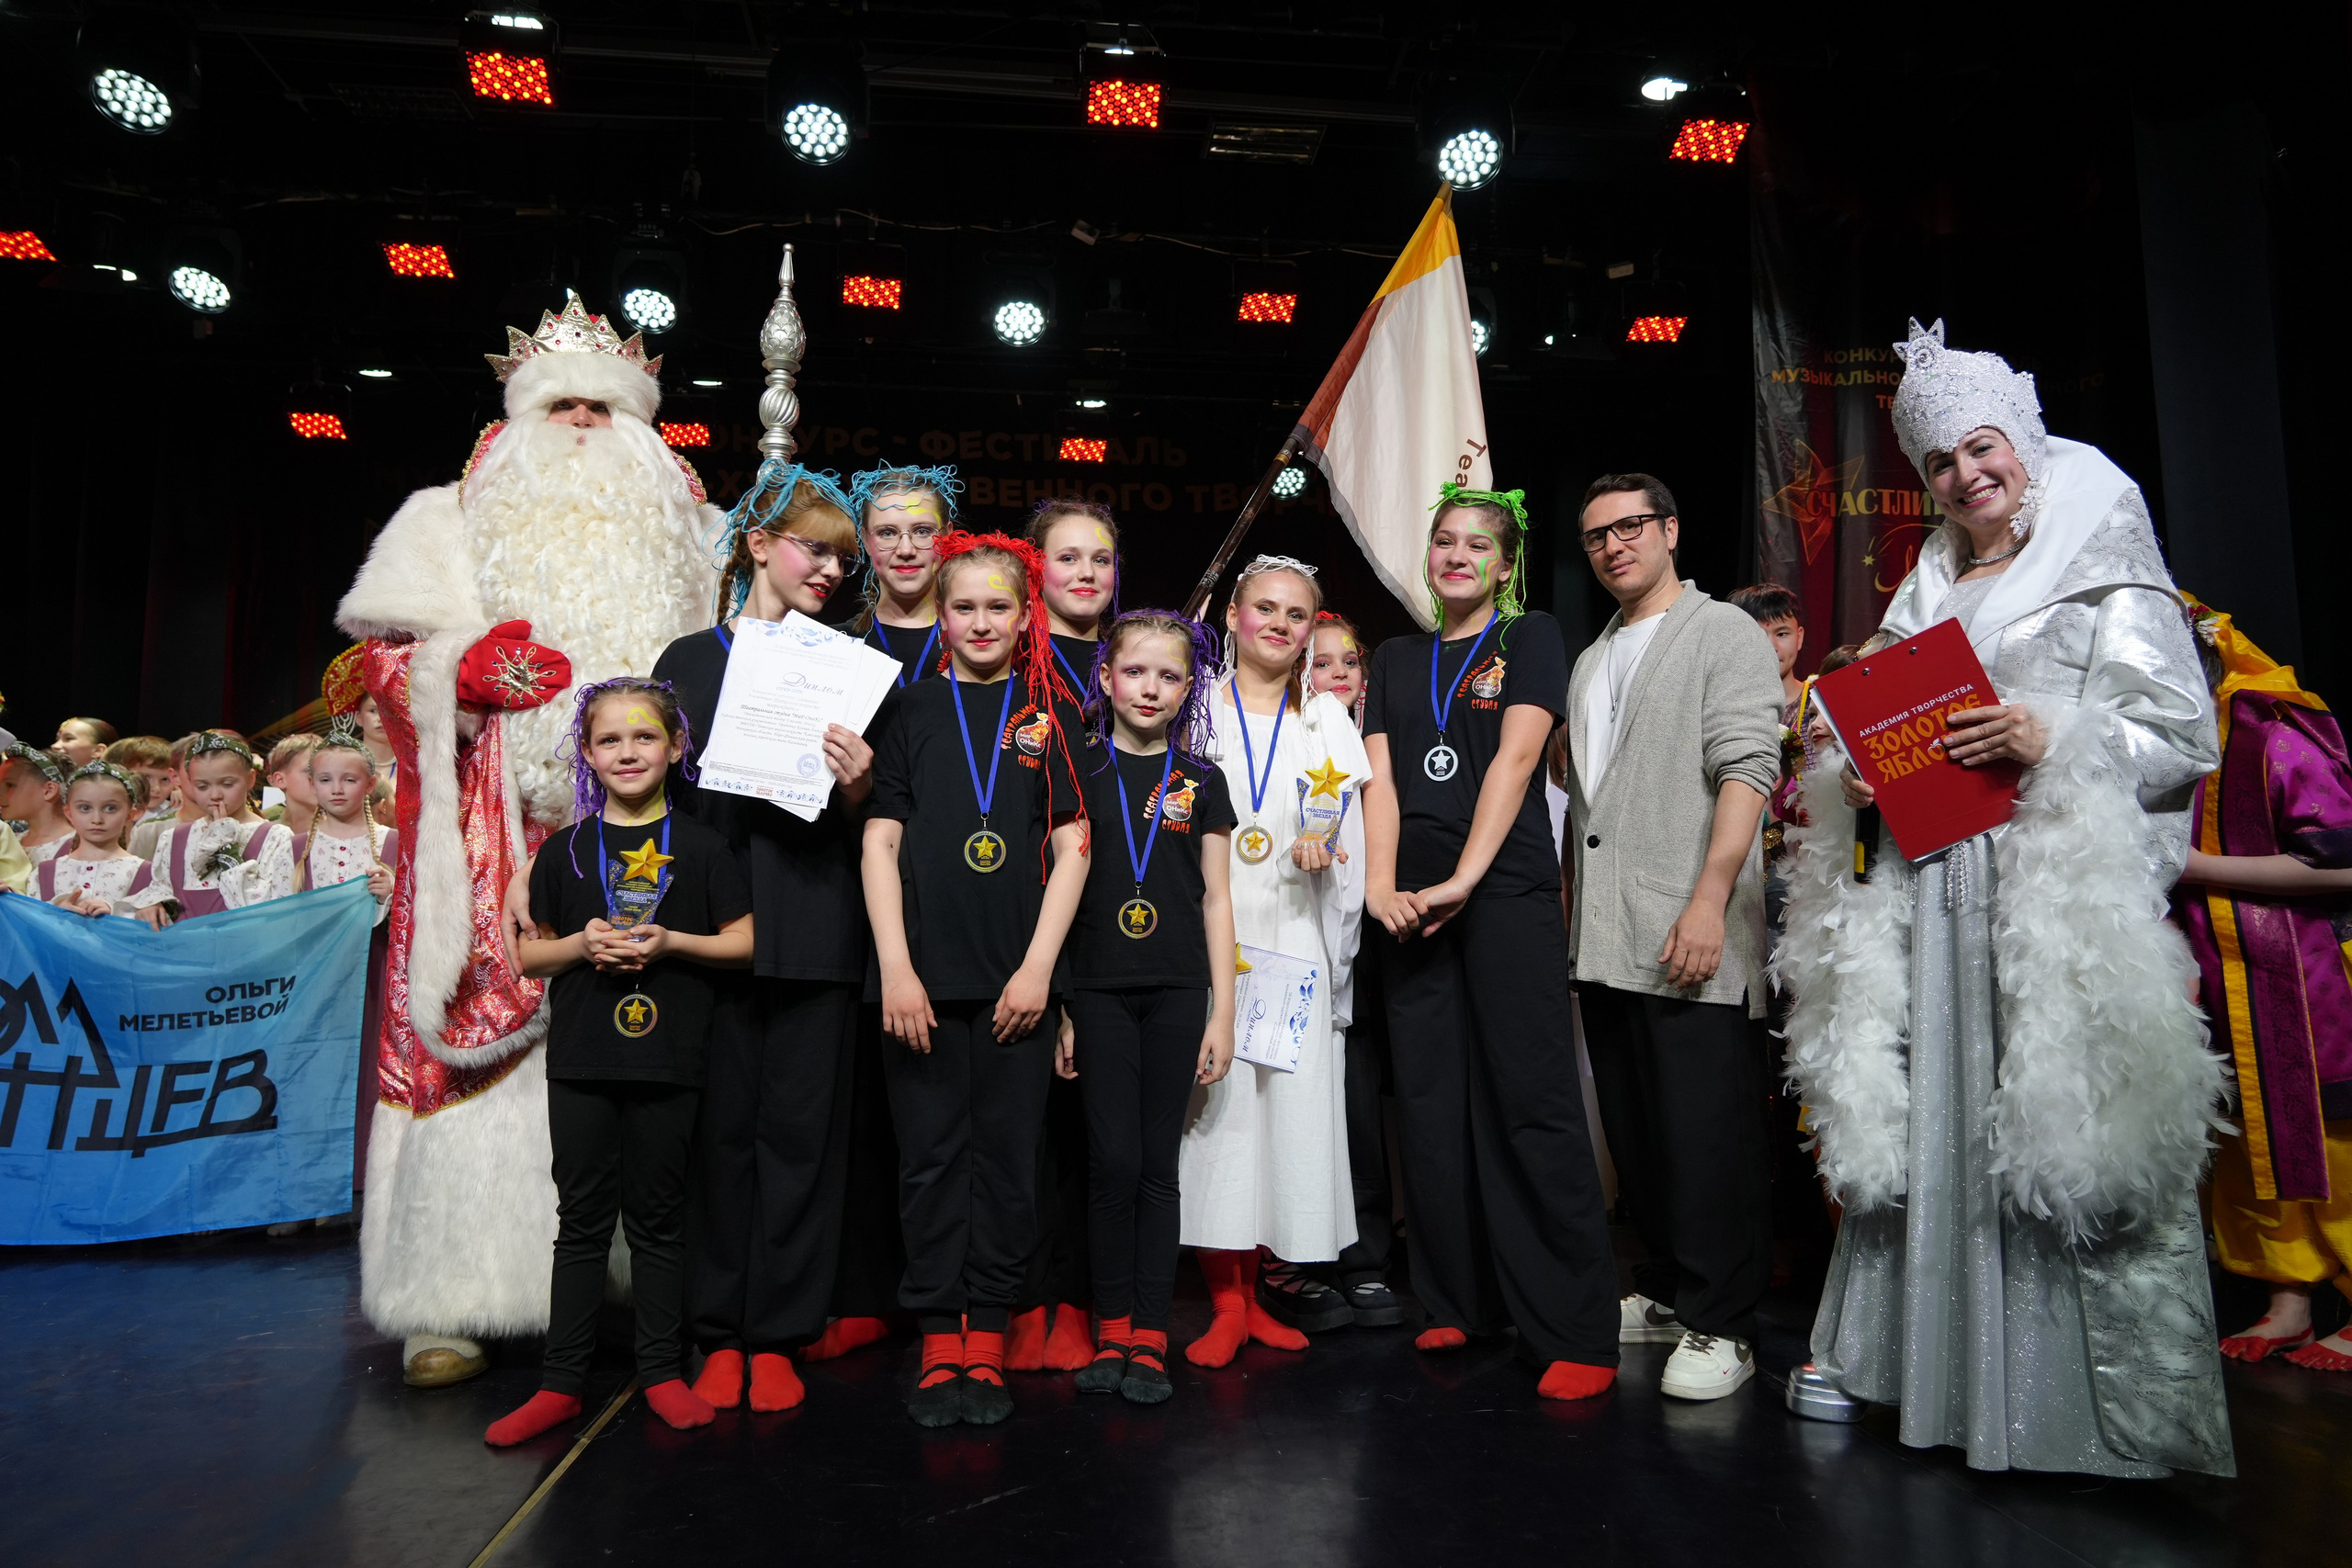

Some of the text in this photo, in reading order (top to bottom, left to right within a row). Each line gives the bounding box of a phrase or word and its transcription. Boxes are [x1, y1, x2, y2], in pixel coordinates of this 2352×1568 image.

[781, 671, 844, 696] Диплом
[1860, 682, 1974, 738] АКАДЕМИЯ ТВОРЧЕСТВА
[1862, 694, 1981, 760] ЗОЛОТОЕ
[1876, 734, 1948, 784] ЯБЛО
[205, 976, 297, 1004] ОЛЬГИ
[119, 994, 289, 1032] МЕЛЕТЬЕВОЙ
